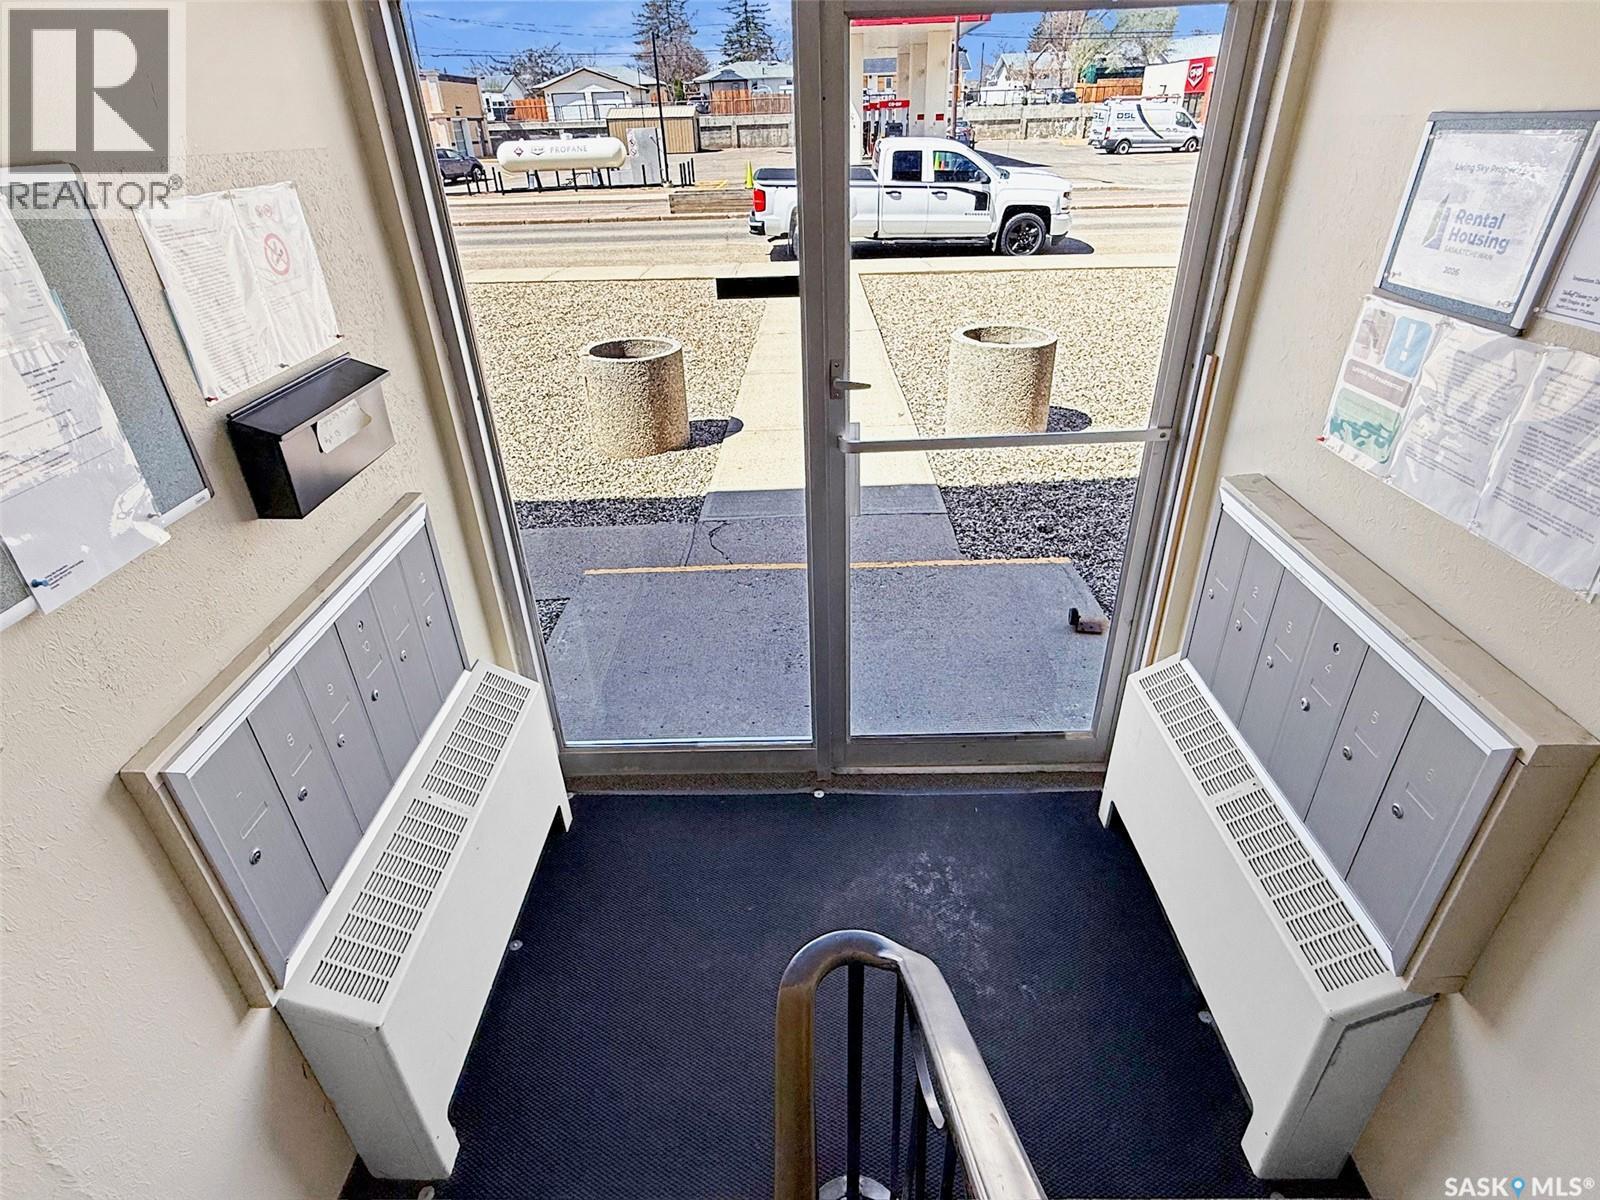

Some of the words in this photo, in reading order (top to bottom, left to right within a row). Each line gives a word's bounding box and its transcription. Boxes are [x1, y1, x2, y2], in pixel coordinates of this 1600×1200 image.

[550, 145, 588, 153] PROPANE
[1455, 209, 1506, 230] Rental
[1448, 226, 1510, 255] Housing
